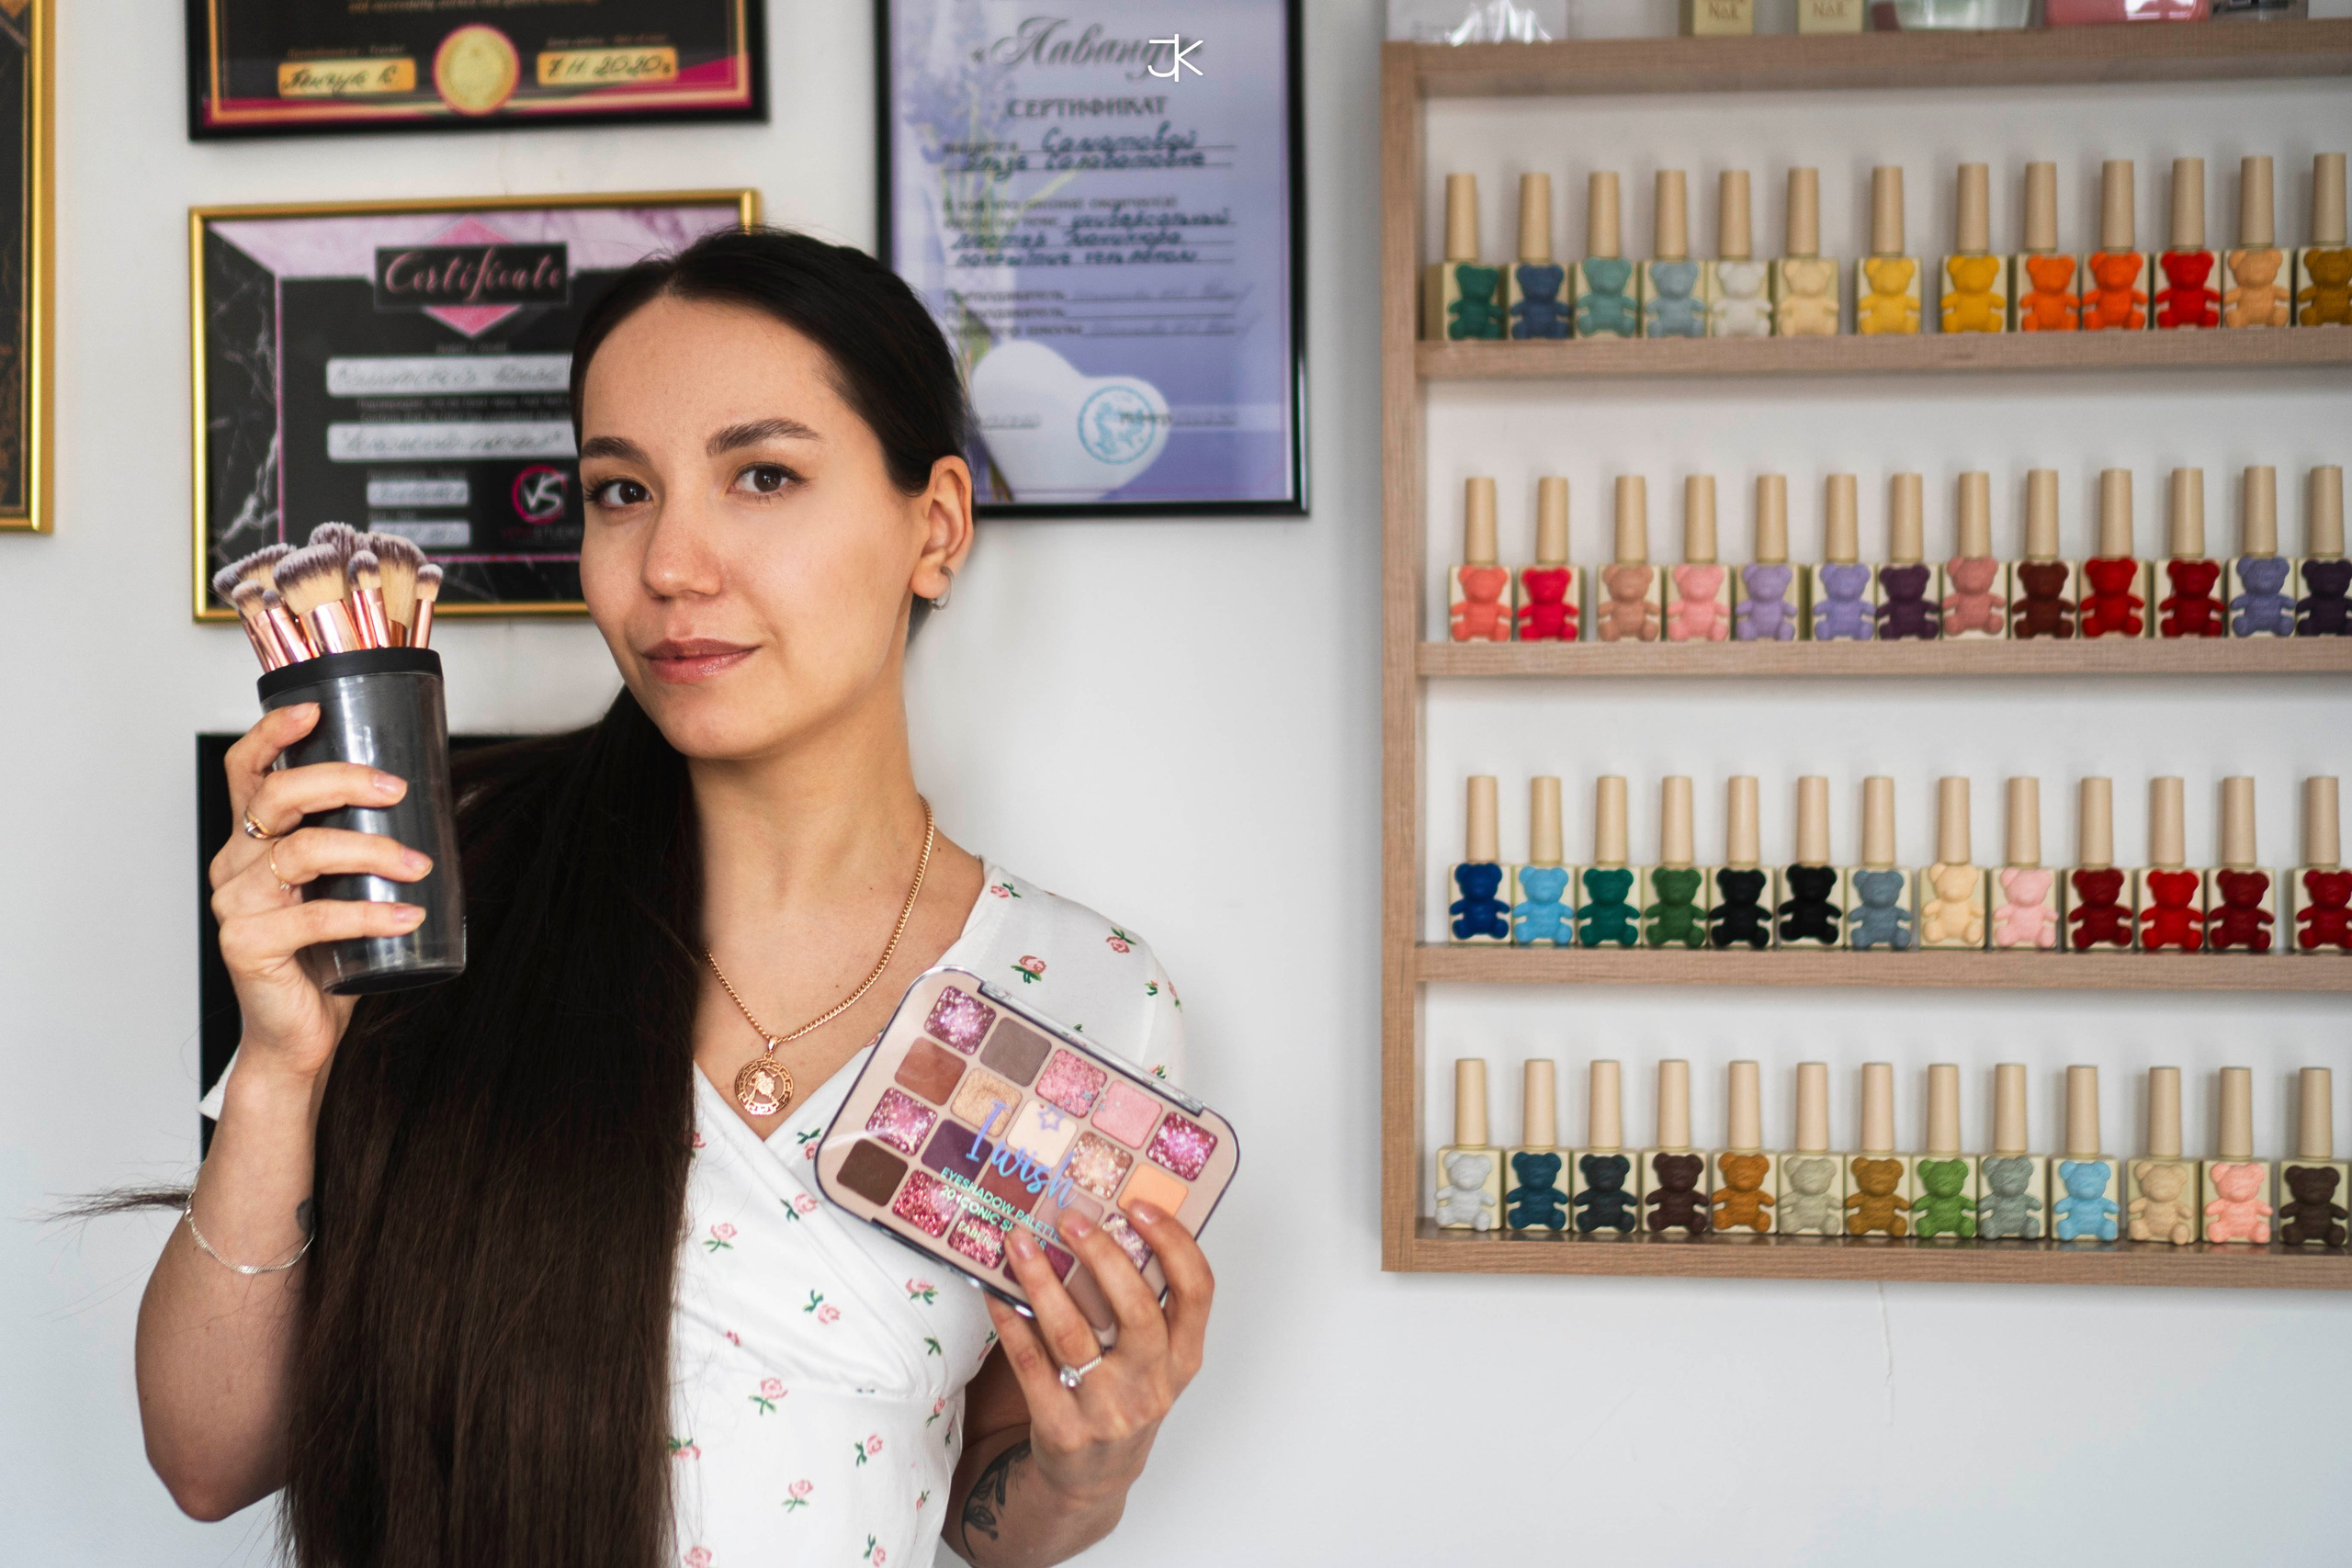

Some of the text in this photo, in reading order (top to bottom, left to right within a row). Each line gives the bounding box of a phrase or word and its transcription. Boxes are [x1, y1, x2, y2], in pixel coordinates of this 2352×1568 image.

[1007, 96, 1168, 118] СЕРТИФИКАТ
[385, 247, 560, 301] Certificate
[966, 1100, 1079, 1209] I wish
[940, 1166, 1015, 1214] EYESHADOW
[940, 1184, 1001, 1225] 20 ICONIC
